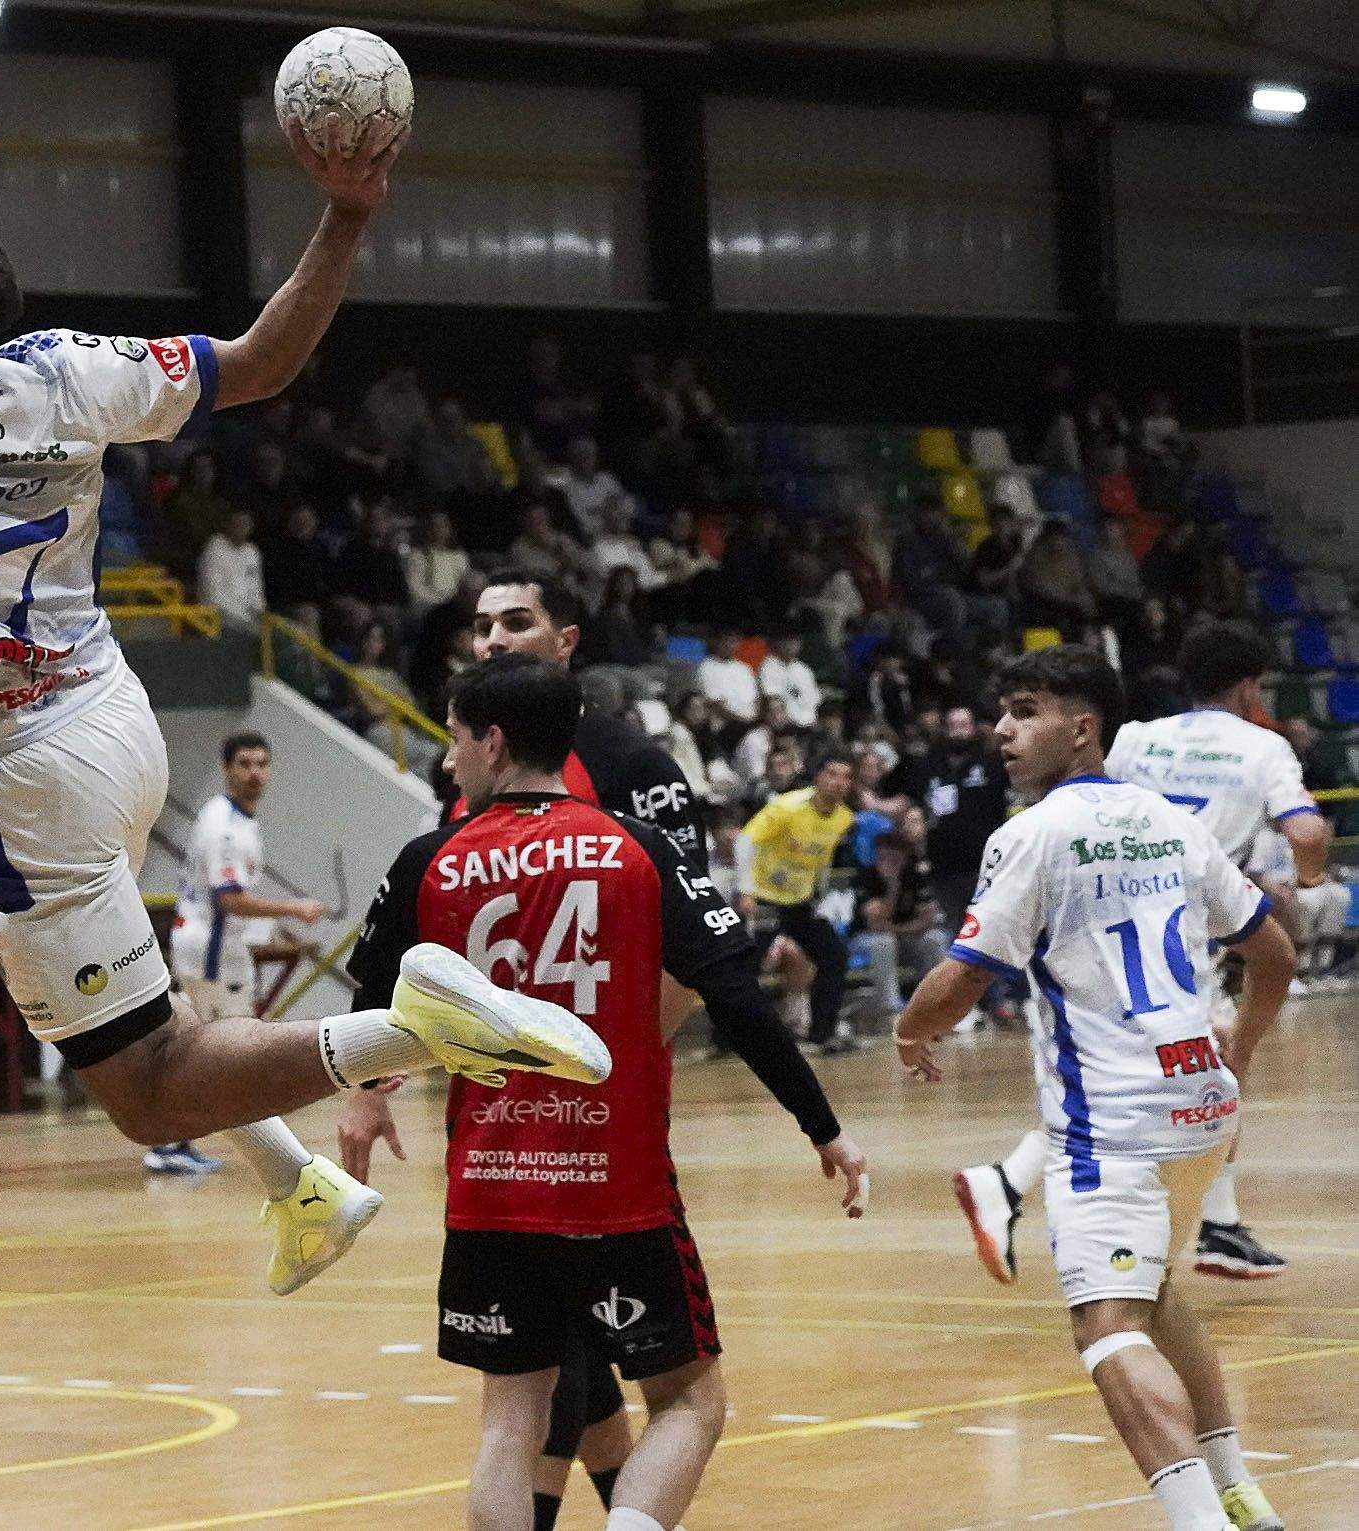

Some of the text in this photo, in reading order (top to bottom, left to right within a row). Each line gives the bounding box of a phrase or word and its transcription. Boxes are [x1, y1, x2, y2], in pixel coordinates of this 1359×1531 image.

[438, 835, 624, 892] SANCHEZ
[1070, 837, 1116, 866] Los
[466, 879, 612, 1015] 64
[466, 1150, 609, 1166] TOYOTA AUTOBAFER
[462, 1166, 609, 1186] autobafer.toyota.es
